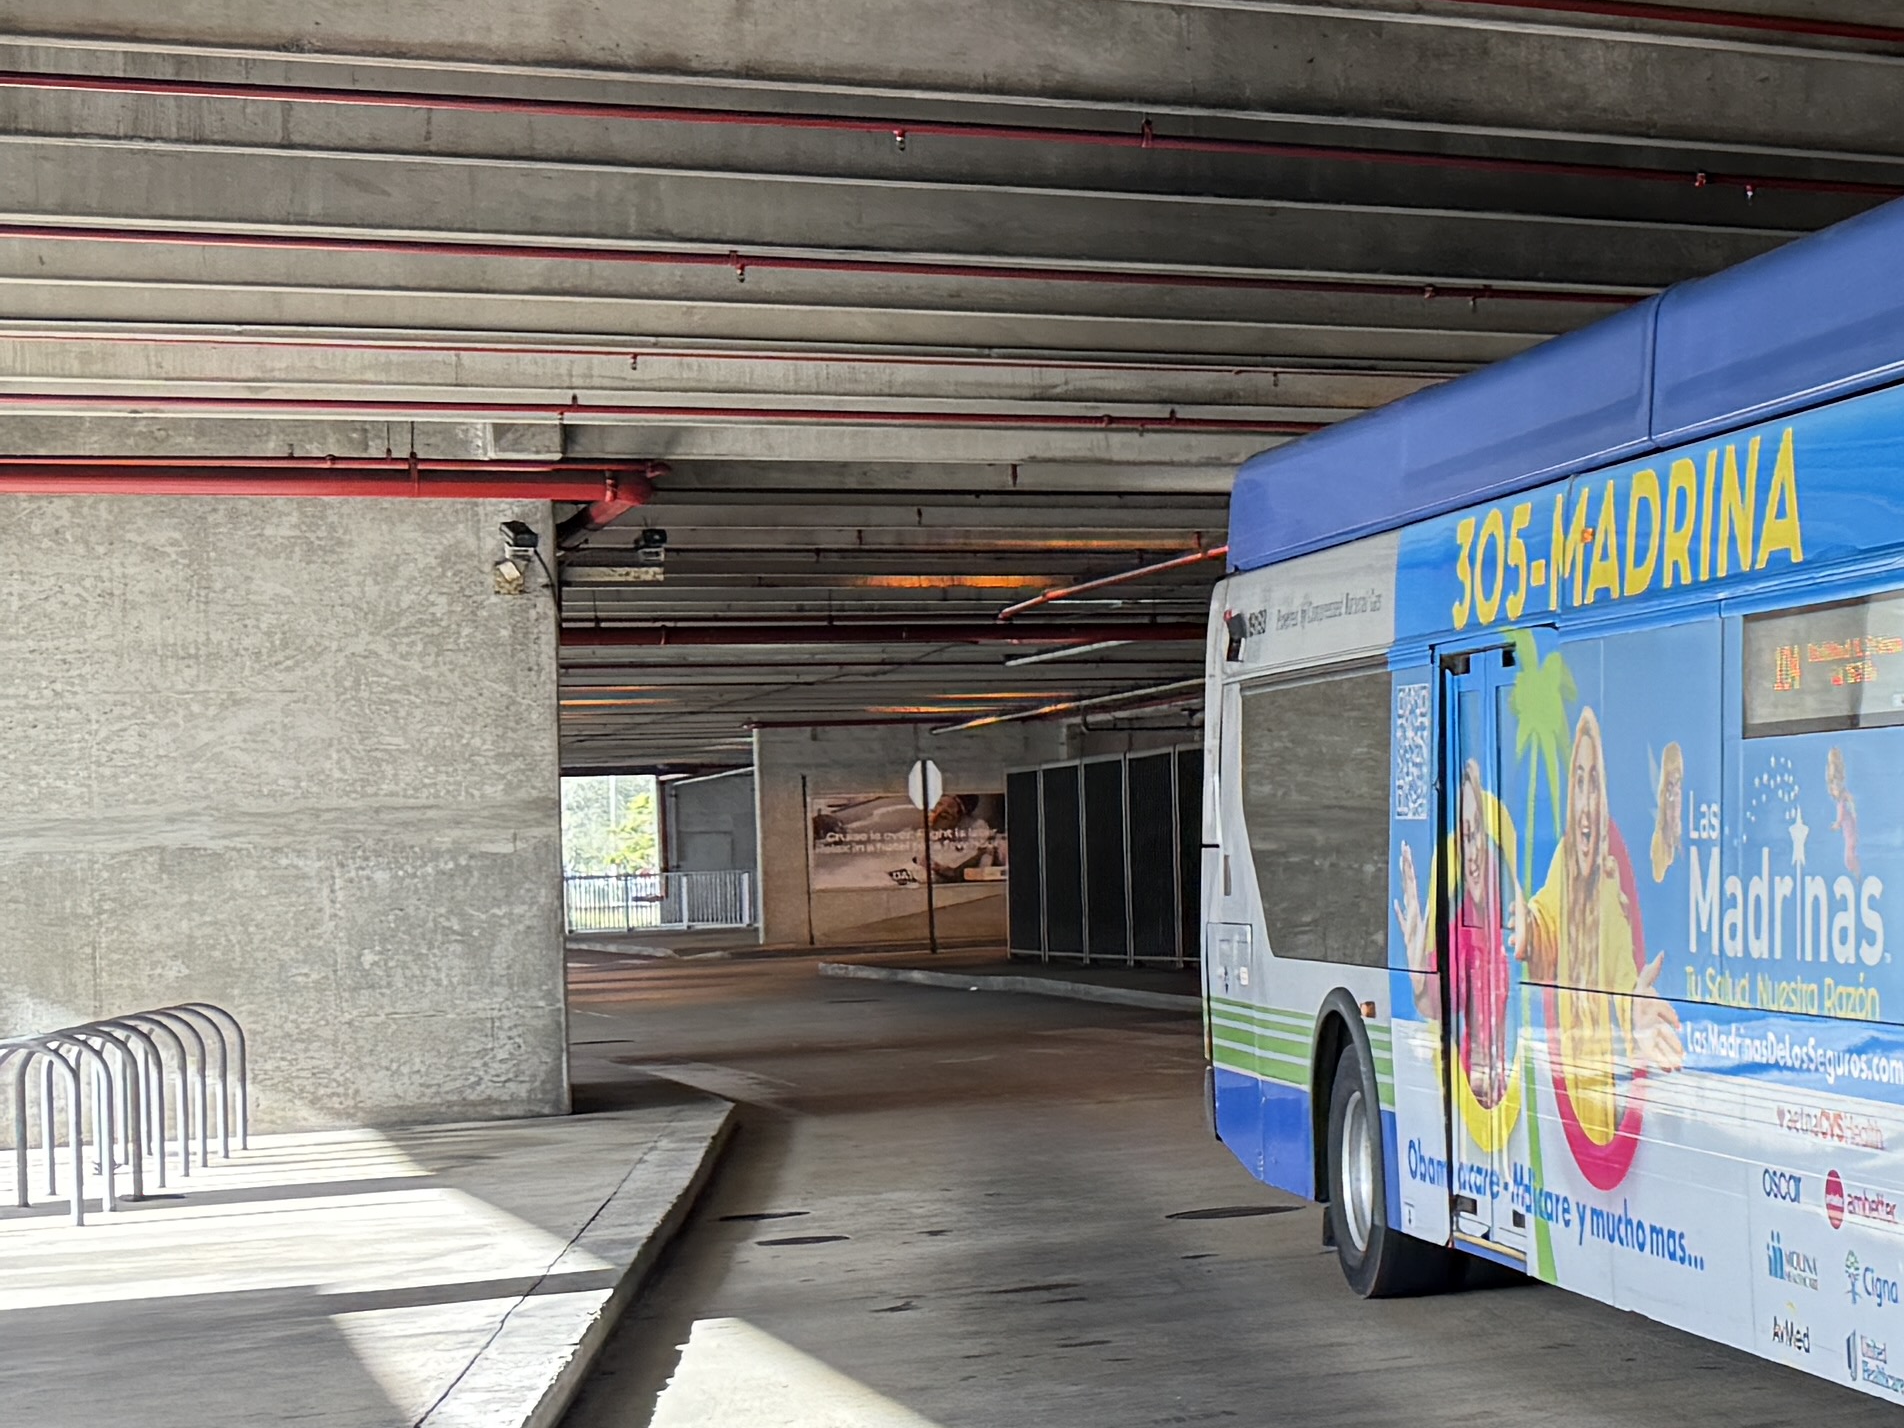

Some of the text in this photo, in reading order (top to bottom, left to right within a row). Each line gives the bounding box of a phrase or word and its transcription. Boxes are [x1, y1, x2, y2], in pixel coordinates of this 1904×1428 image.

[1452, 427, 1803, 630] 305-MADRINA
[1689, 790, 1720, 839] Las
[1690, 844, 1884, 966] Madrinas
[1685, 966, 1701, 1002] Tu
[1757, 971, 1818, 1014] Nuestra
[1824, 972, 1880, 1020] Razón
[1762, 1168, 1801, 1204] oscar
[1576, 1201, 1588, 1246] y
[1590, 1197, 1646, 1252] mucho
[1862, 1266, 1898, 1308] Cigna
